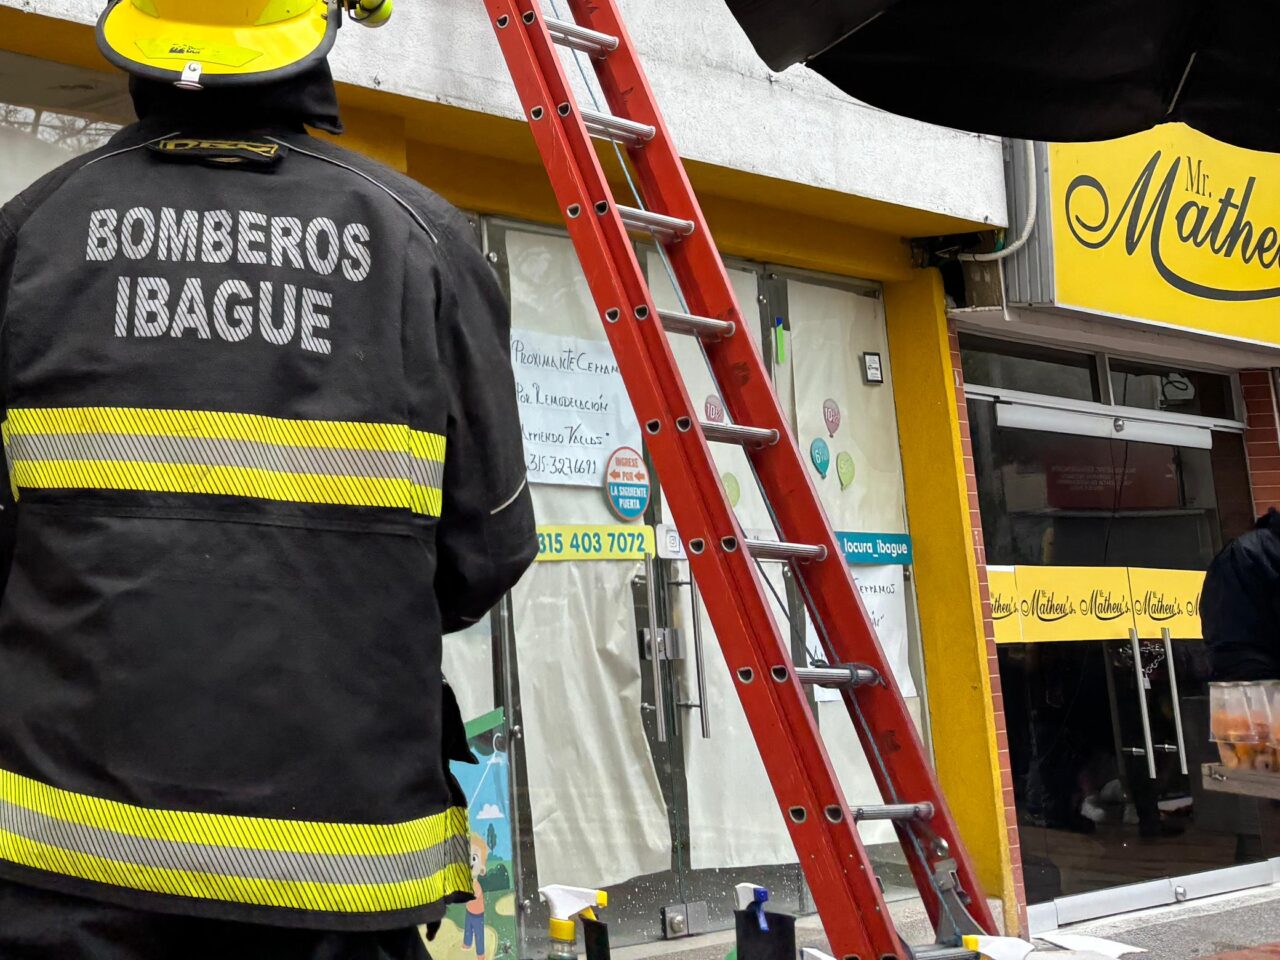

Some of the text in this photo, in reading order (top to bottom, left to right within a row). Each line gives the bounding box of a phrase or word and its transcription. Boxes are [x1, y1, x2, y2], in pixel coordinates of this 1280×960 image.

[1185, 156, 1212, 198] Mr.
[85, 206, 371, 282] BOMBEROS
[1065, 150, 1280, 301] Mathe
[114, 275, 333, 355] IBAGUE
[610, 485, 618, 496] LA
[538, 532, 645, 554] 315 403 7072
